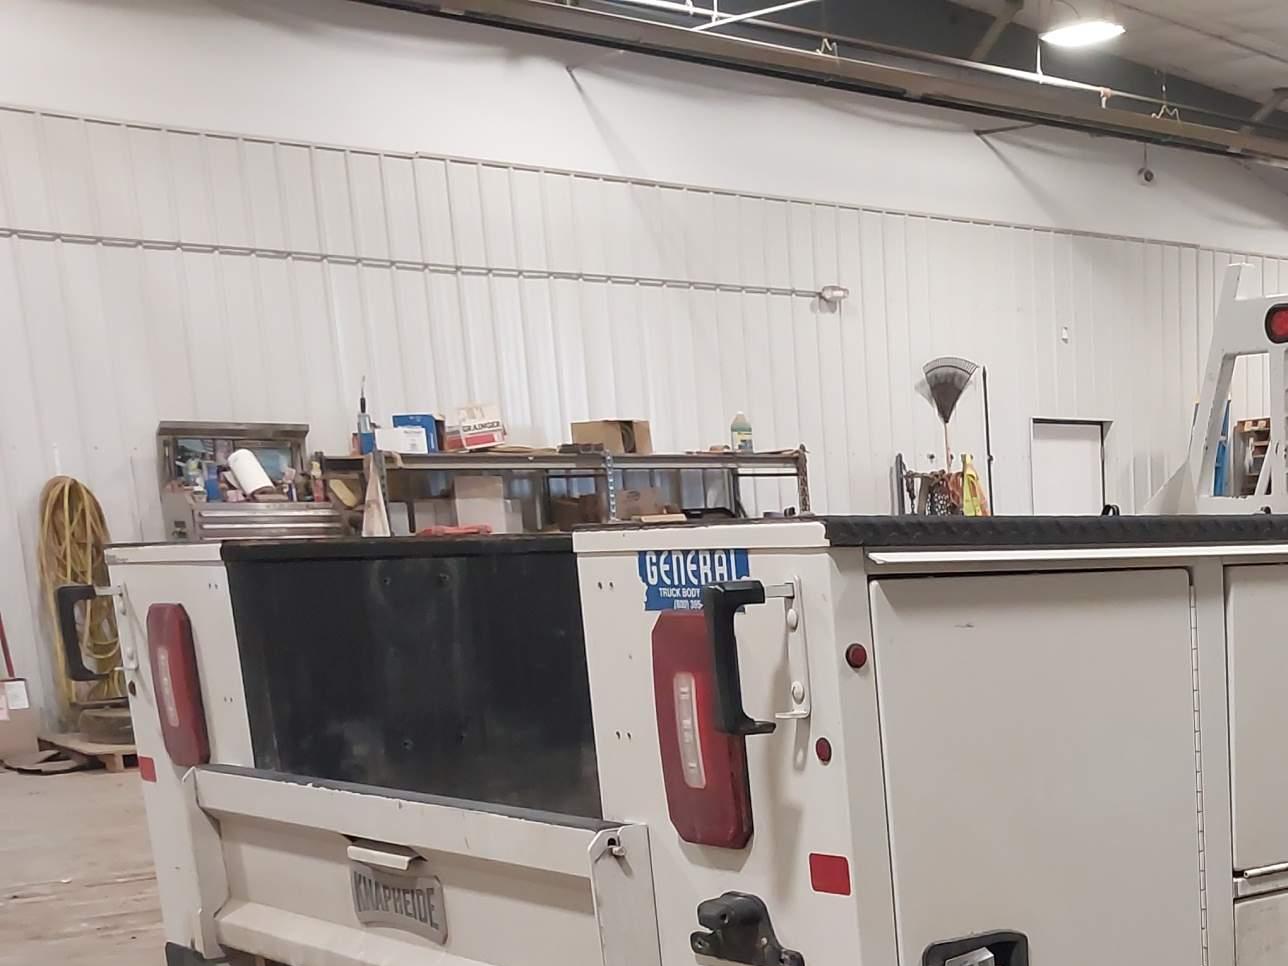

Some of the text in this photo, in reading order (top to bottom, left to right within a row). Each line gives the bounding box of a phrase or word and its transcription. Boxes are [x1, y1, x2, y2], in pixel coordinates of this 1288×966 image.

[645, 550, 738, 585] GENERAL
[659, 587, 701, 598] TRUCK BODY
[353, 871, 440, 930] KNAPHEIDE
